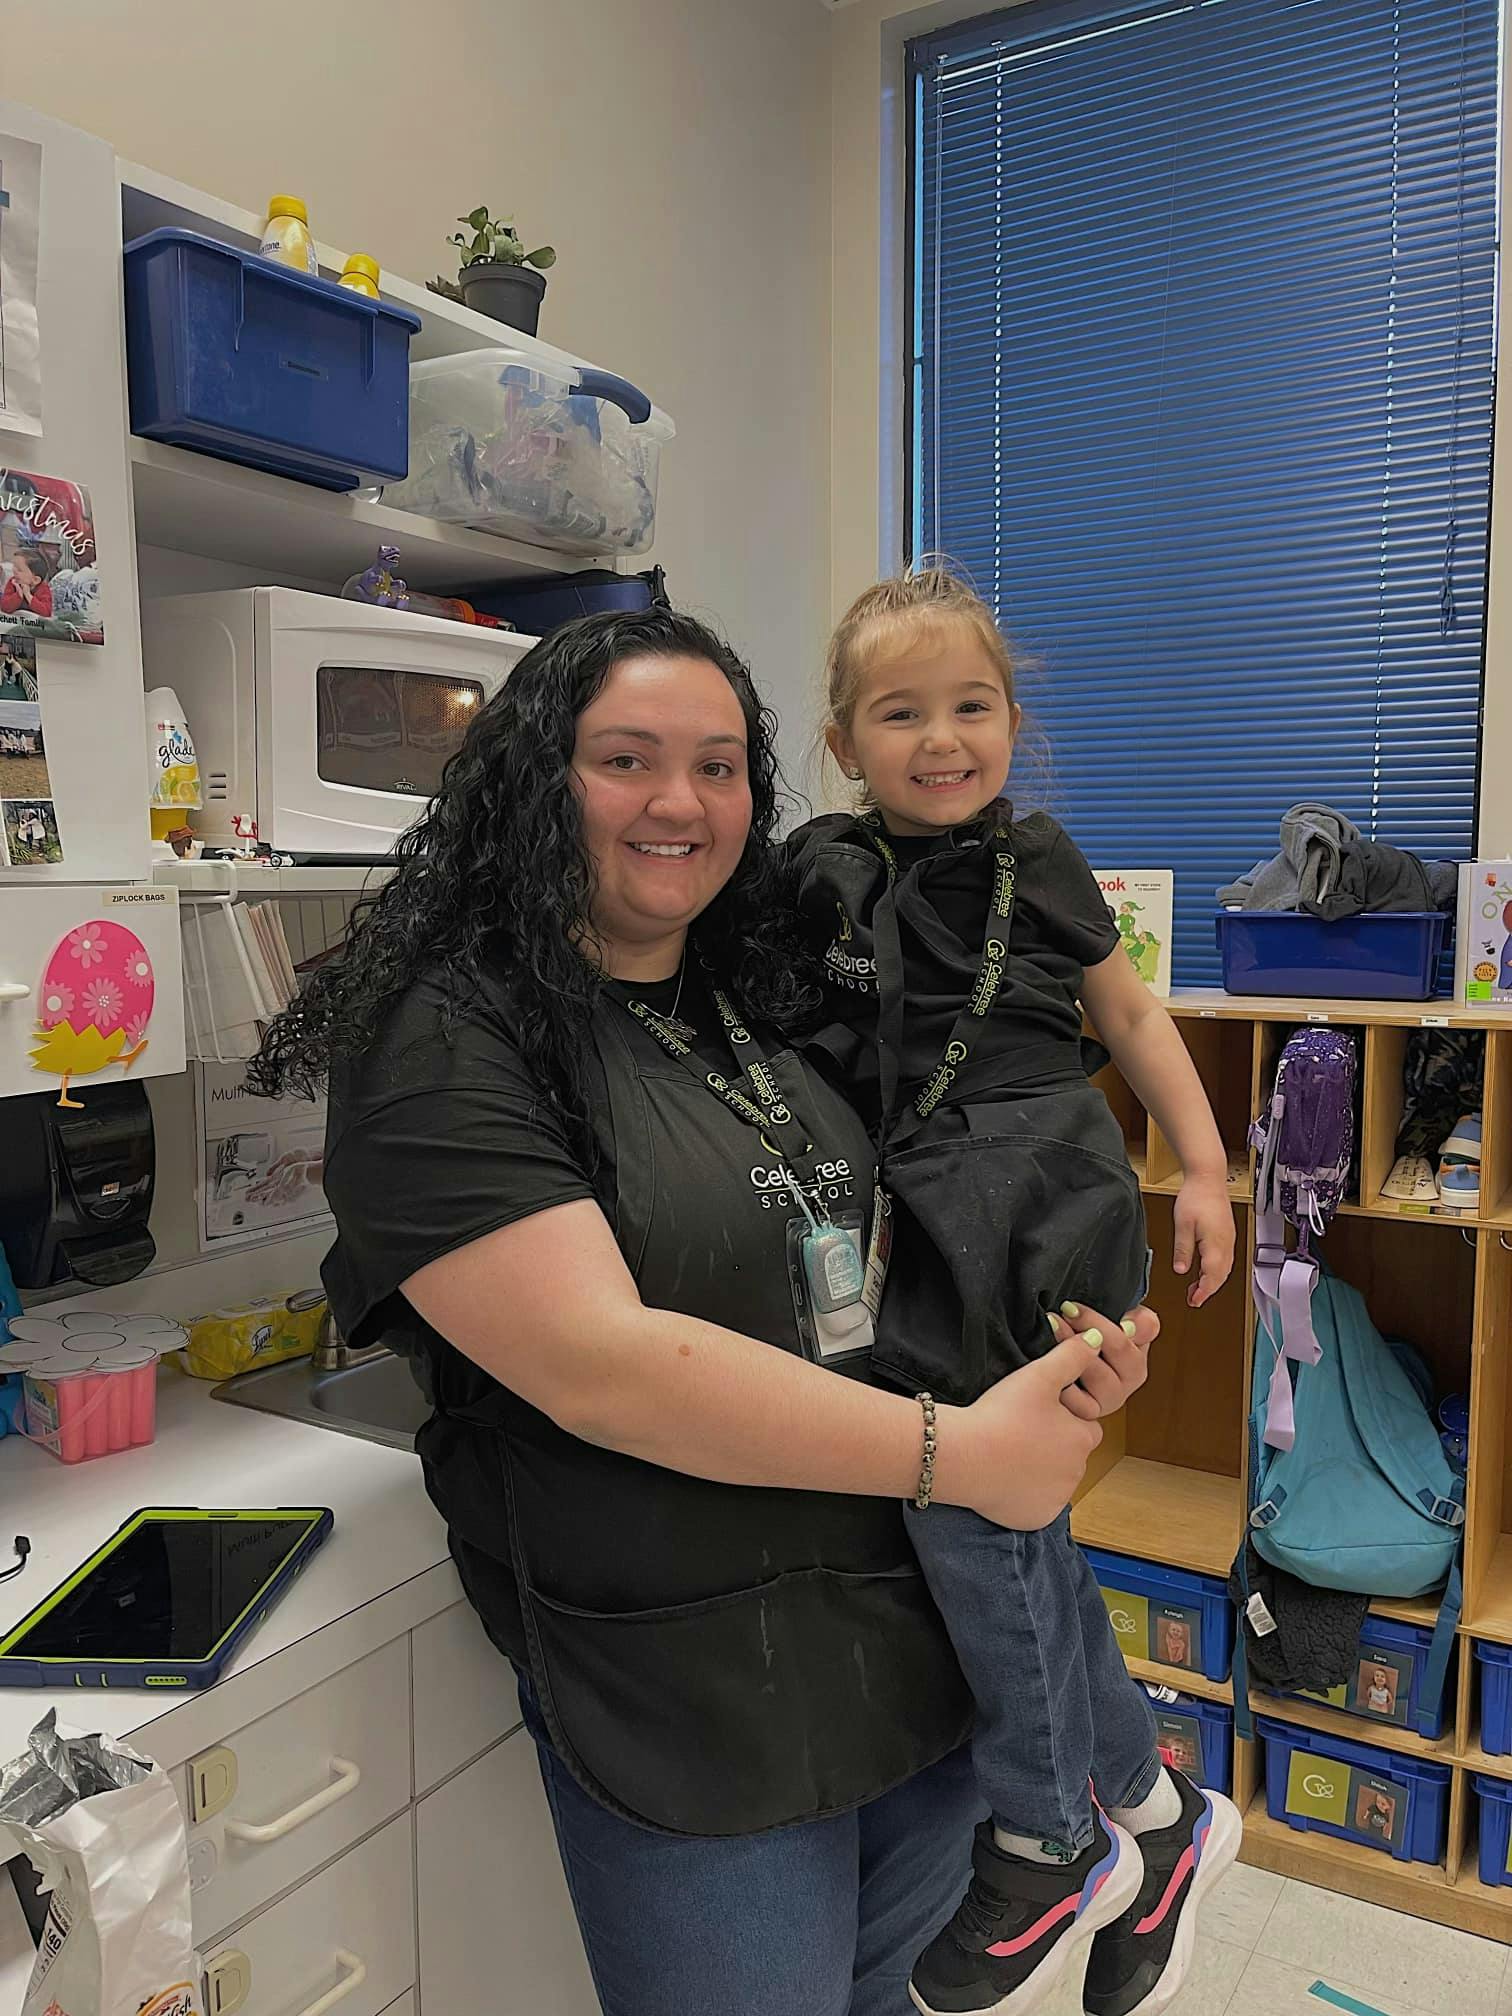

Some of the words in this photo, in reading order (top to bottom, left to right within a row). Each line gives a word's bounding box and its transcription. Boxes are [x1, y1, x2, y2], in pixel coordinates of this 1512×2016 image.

[112, 894, 144, 903] ZIPLOCK
[1000, 871, 1015, 918] Celebree
[1098, 876, 1126, 891] ook
[976, 964, 1003, 1017] Celebree
[747, 1064, 773, 1105] Celebree
[760, 1062, 783, 1101] SCHOOL
[919, 1068, 956, 1118] Celebree
[750, 1159, 850, 1189] Celeree
[761, 1183, 854, 1209] SCOL
